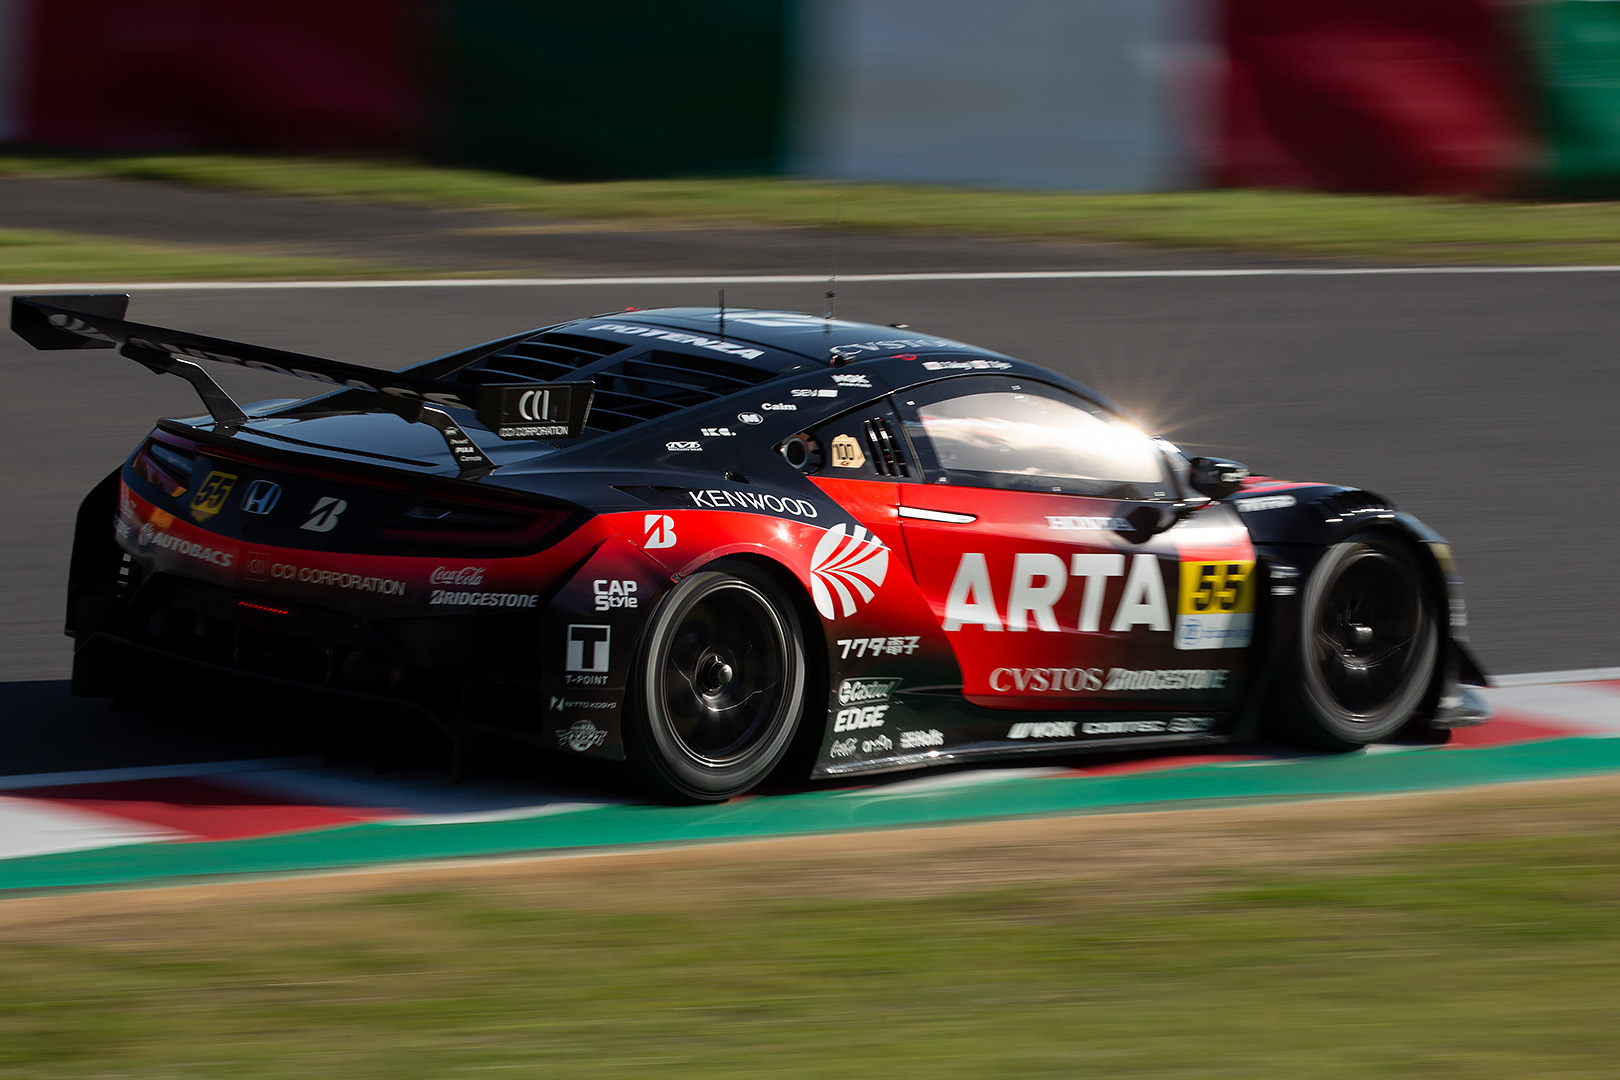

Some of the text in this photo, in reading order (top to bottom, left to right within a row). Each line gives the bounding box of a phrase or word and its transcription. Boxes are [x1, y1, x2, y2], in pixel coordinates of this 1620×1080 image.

[586, 323, 766, 361] POTENZA
[515, 425, 569, 437] CORPORATION
[196, 473, 233, 509] 55
[688, 489, 818, 519] KENWOOD
[151, 531, 234, 568] AUTOBACS
[299, 568, 405, 597] CORPORATION
[593, 579, 638, 596] CAP
[941, 552, 1171, 633] ARTA
[1192, 564, 1244, 612] 55
[429, 589, 540, 608] BRIDGESTONE
[594, 595, 639, 612] Style
[565, 674, 609, 686] T-POINT
[988, 667, 1104, 693] CVSTOS
[834, 705, 890, 734] EDGE
